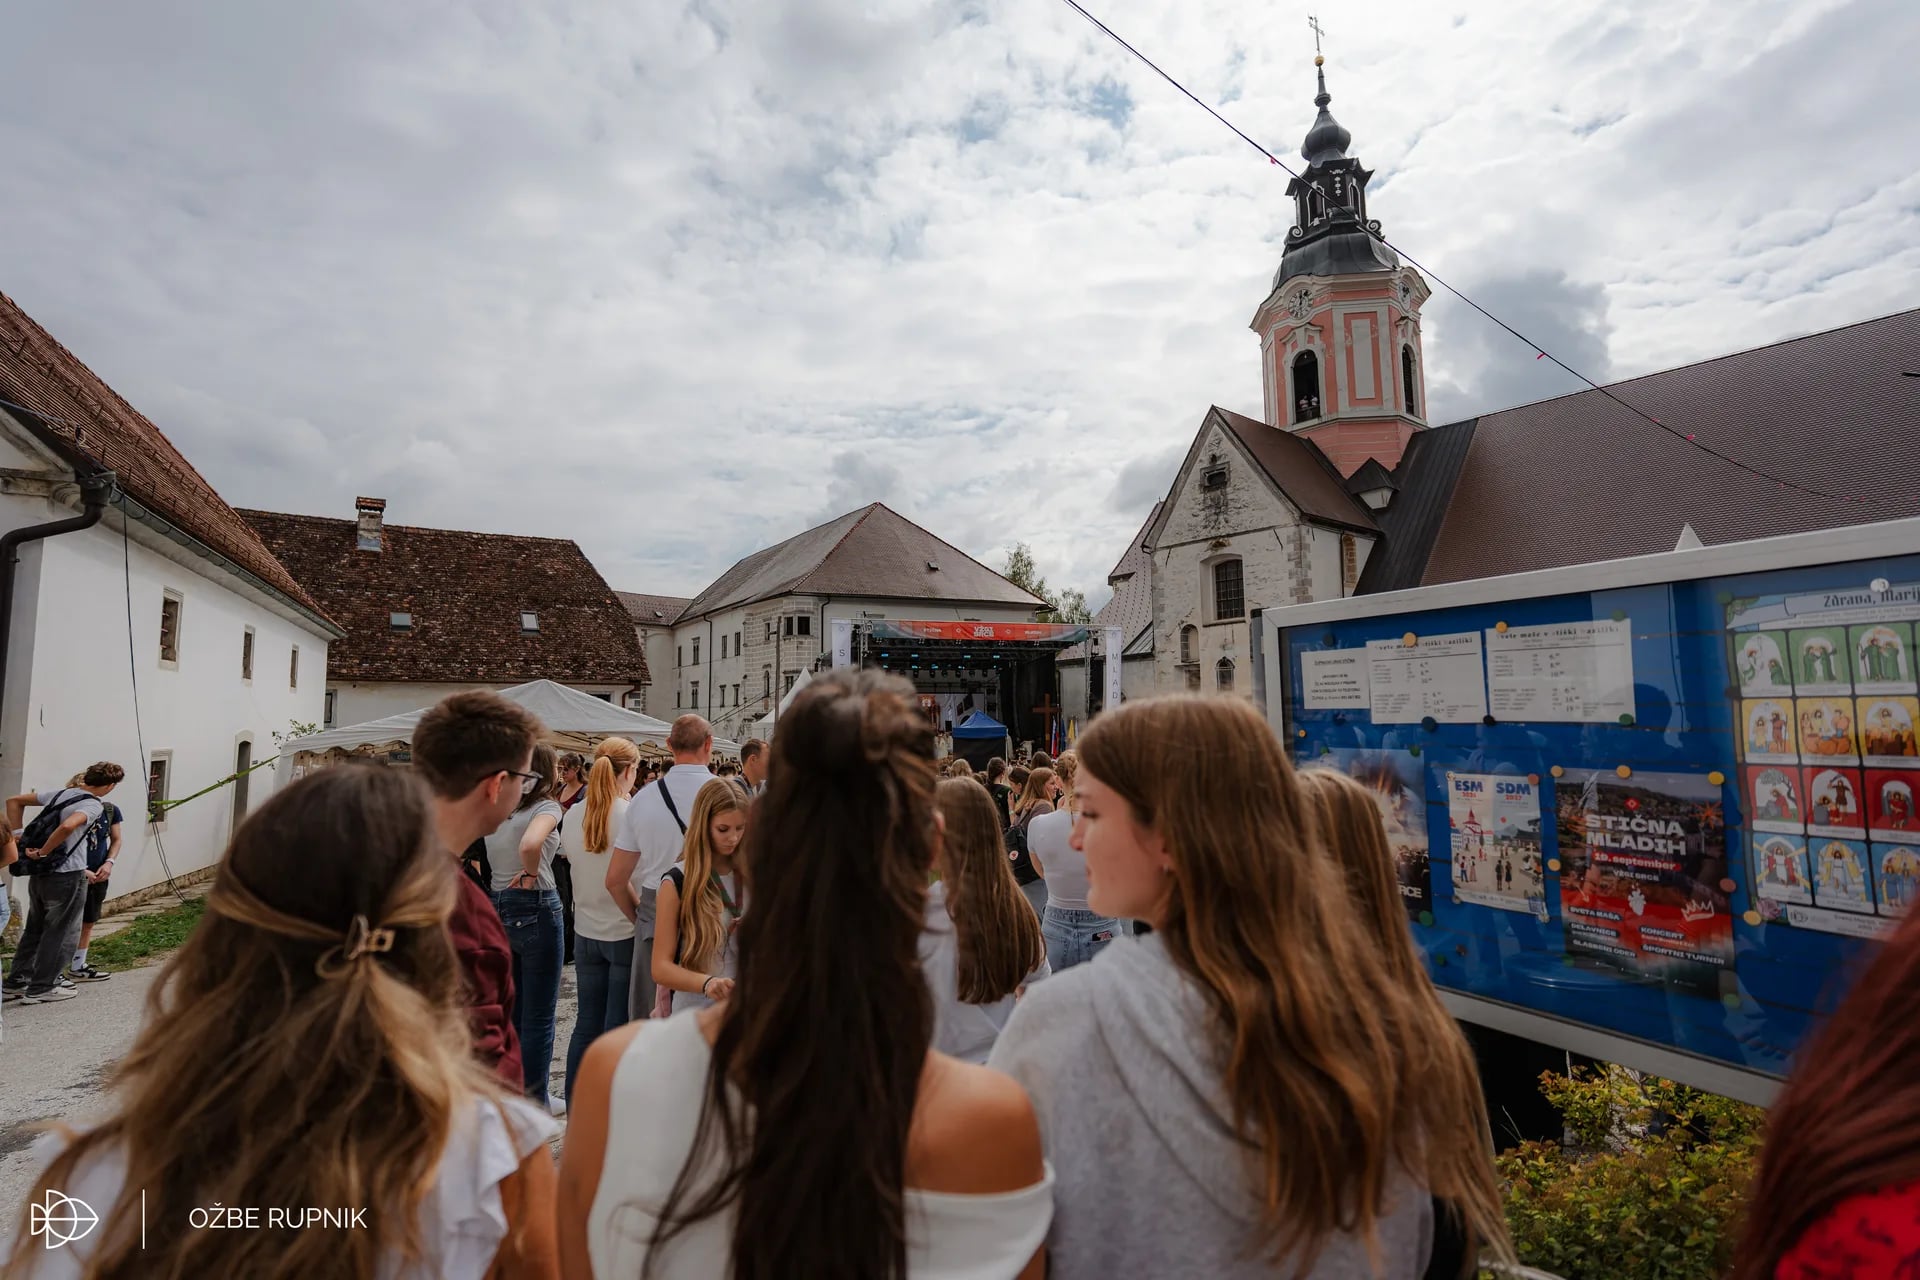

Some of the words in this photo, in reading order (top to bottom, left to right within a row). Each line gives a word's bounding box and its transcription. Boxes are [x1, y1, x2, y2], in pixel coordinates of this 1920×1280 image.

[1823, 594, 1876, 609] Zdrava,
[1454, 780, 1484, 793] ESM
[1495, 782, 1531, 795] SDM
[1585, 814, 1685, 837] STIČNA
[1586, 832, 1687, 856] MLADIH
[1613, 855, 1677, 871] september
[1398, 884, 1423, 899] RCE
[1571, 923, 1617, 937] DELAVNICE
[1640, 927, 1684, 940] KONCERT
[1685, 953, 1725, 966] TURNIR
